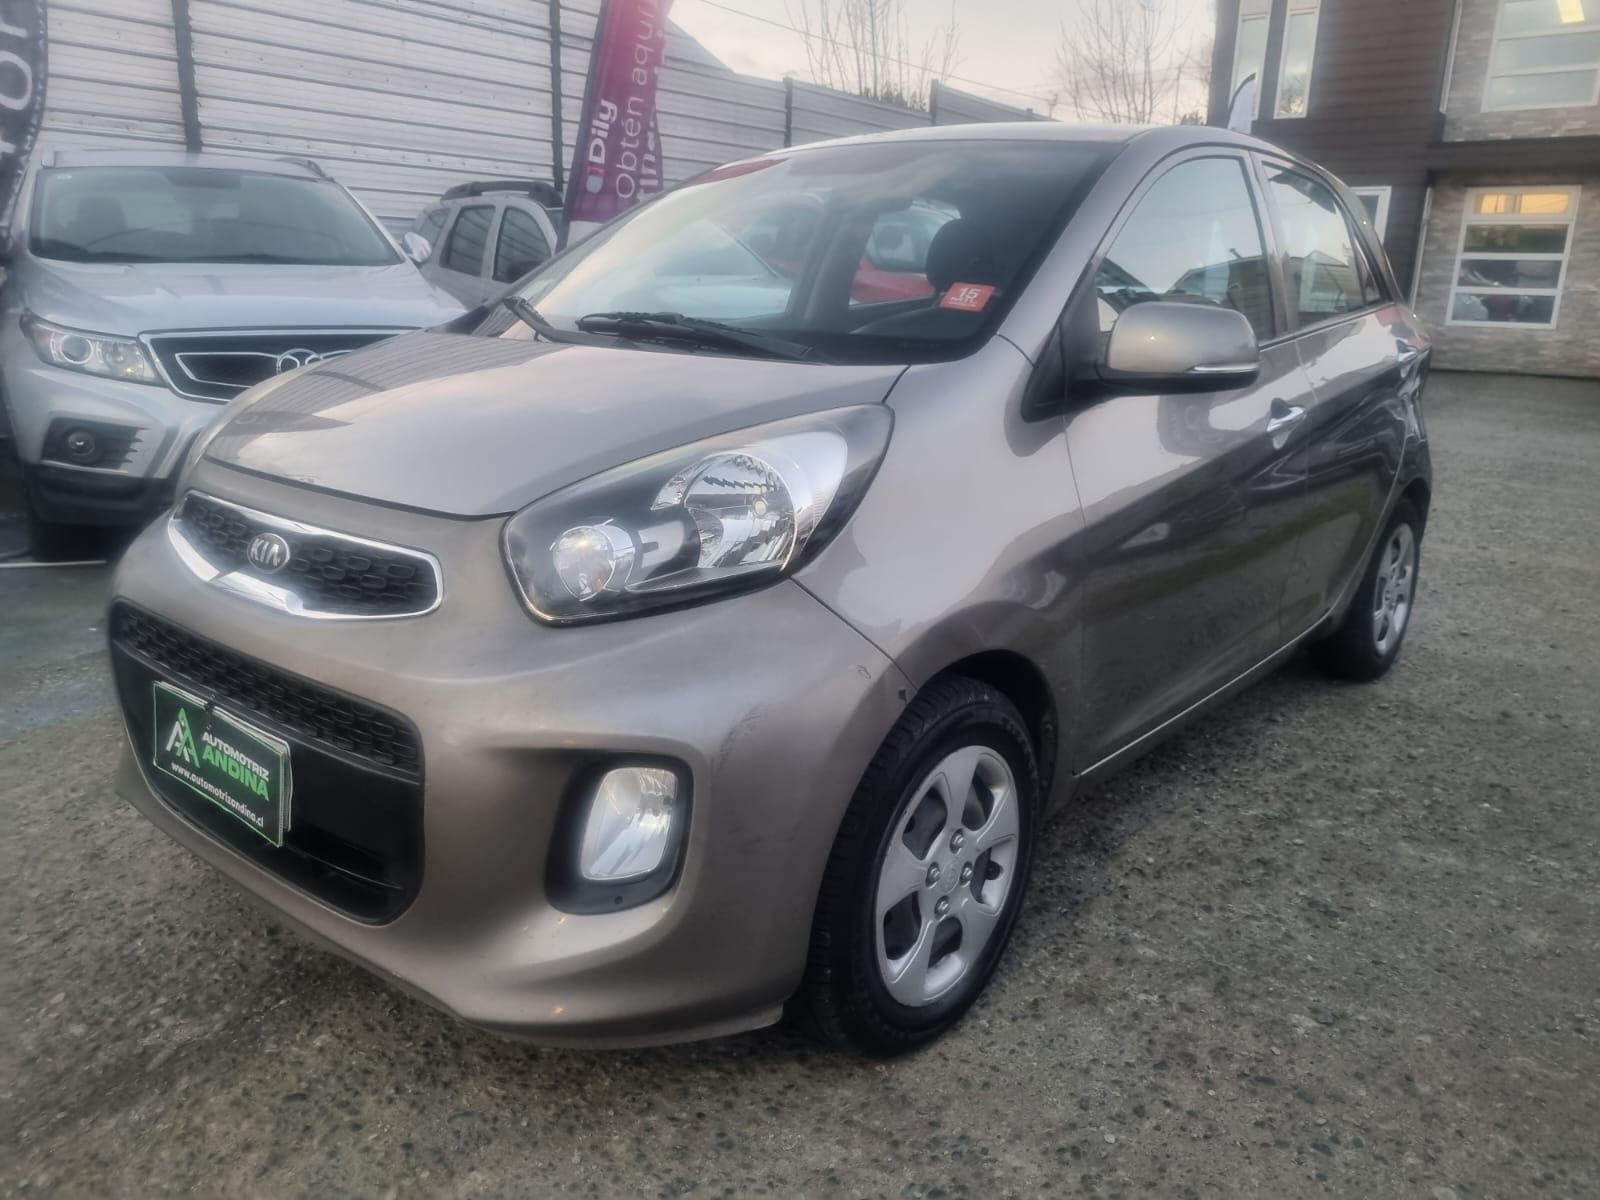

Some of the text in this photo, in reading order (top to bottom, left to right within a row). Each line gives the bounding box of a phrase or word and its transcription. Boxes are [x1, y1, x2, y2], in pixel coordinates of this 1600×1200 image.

[588, 99, 618, 164] Dily
[615, 96, 645, 199] Obtén
[958, 287, 981, 299] 15
[202, 731, 269, 781] AUTOMOTRIZ
[202, 745, 269, 801] ANDINA
[171, 762, 264, 828] www.automotrizandina.cl
